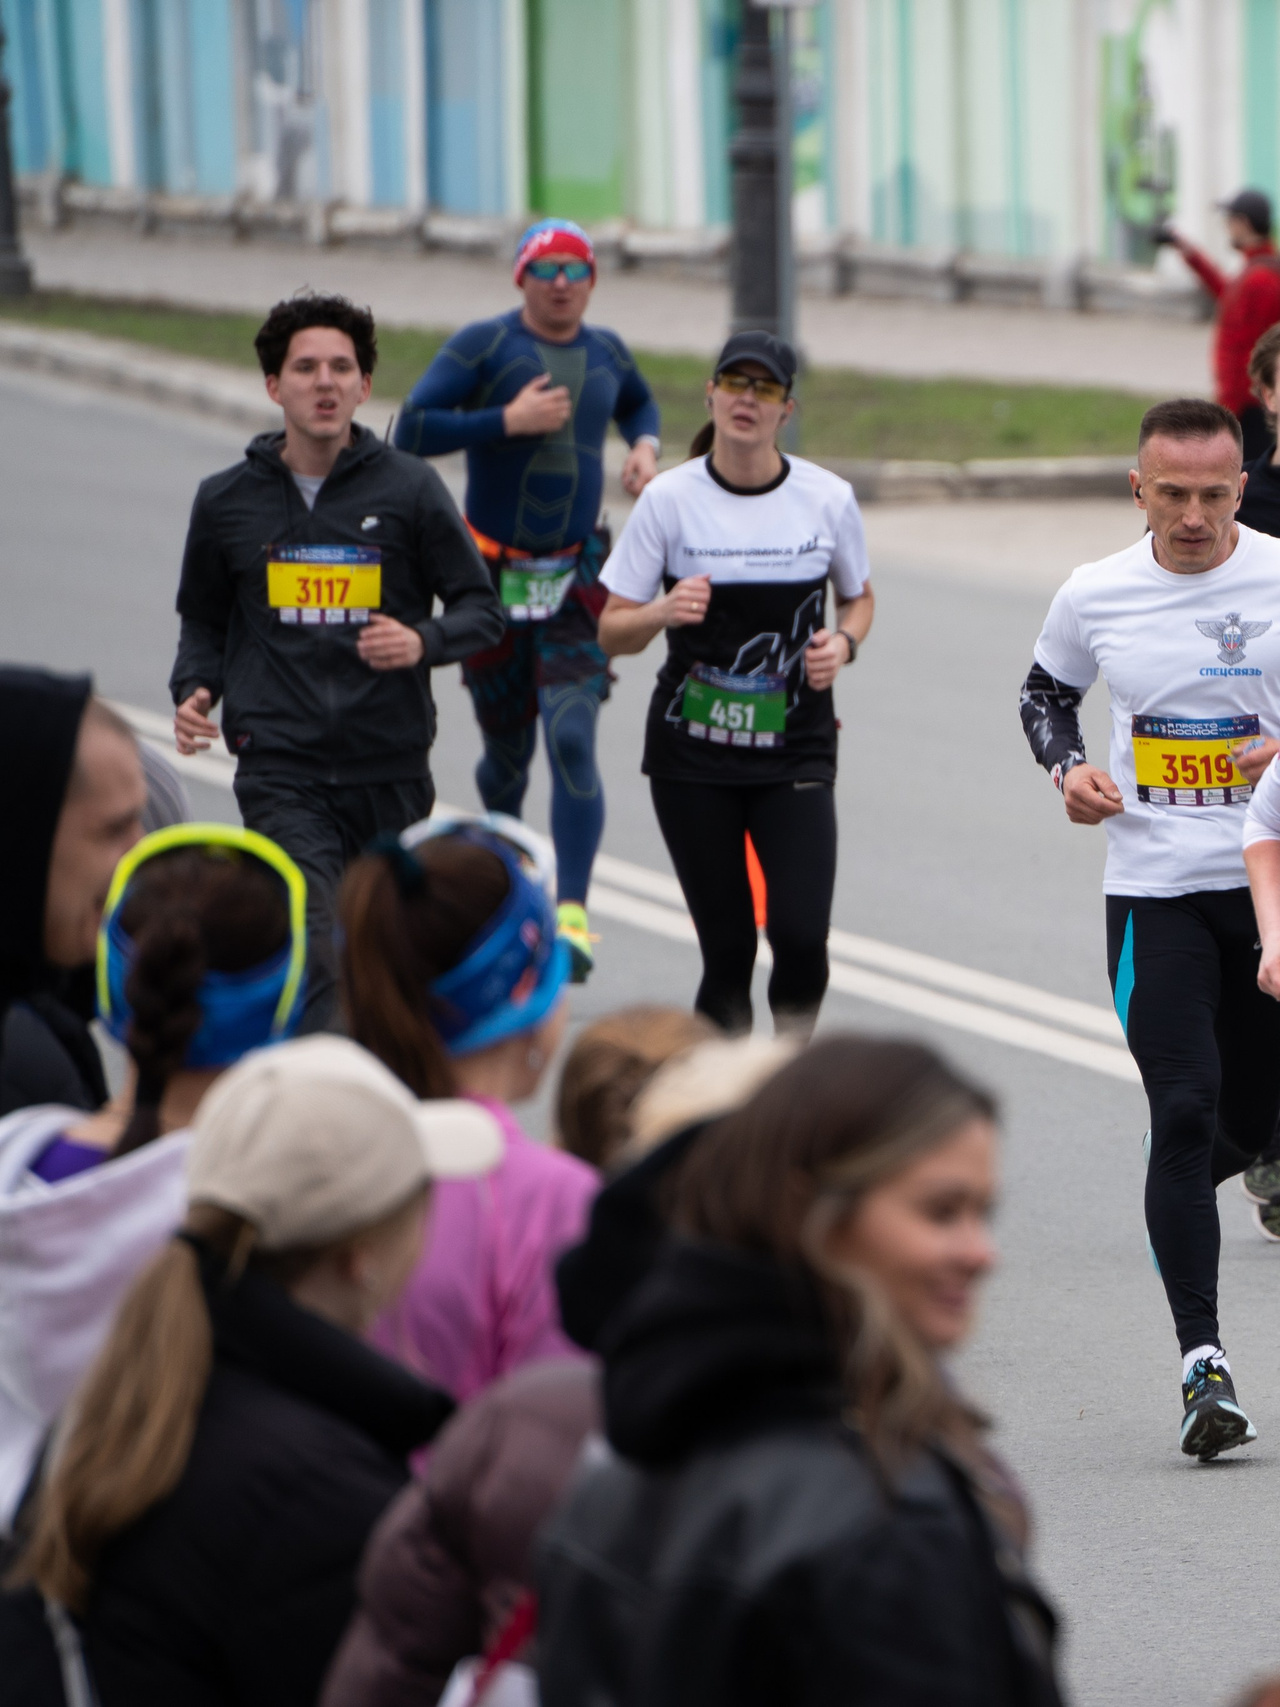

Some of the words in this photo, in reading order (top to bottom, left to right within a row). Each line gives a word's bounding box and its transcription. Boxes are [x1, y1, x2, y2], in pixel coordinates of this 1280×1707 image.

[297, 577, 350, 605] 3117
[1199, 667, 1262, 677] СПЕЦСВЯЗЬ
[709, 699, 755, 731] 451
[1161, 753, 1234, 785] 3519
